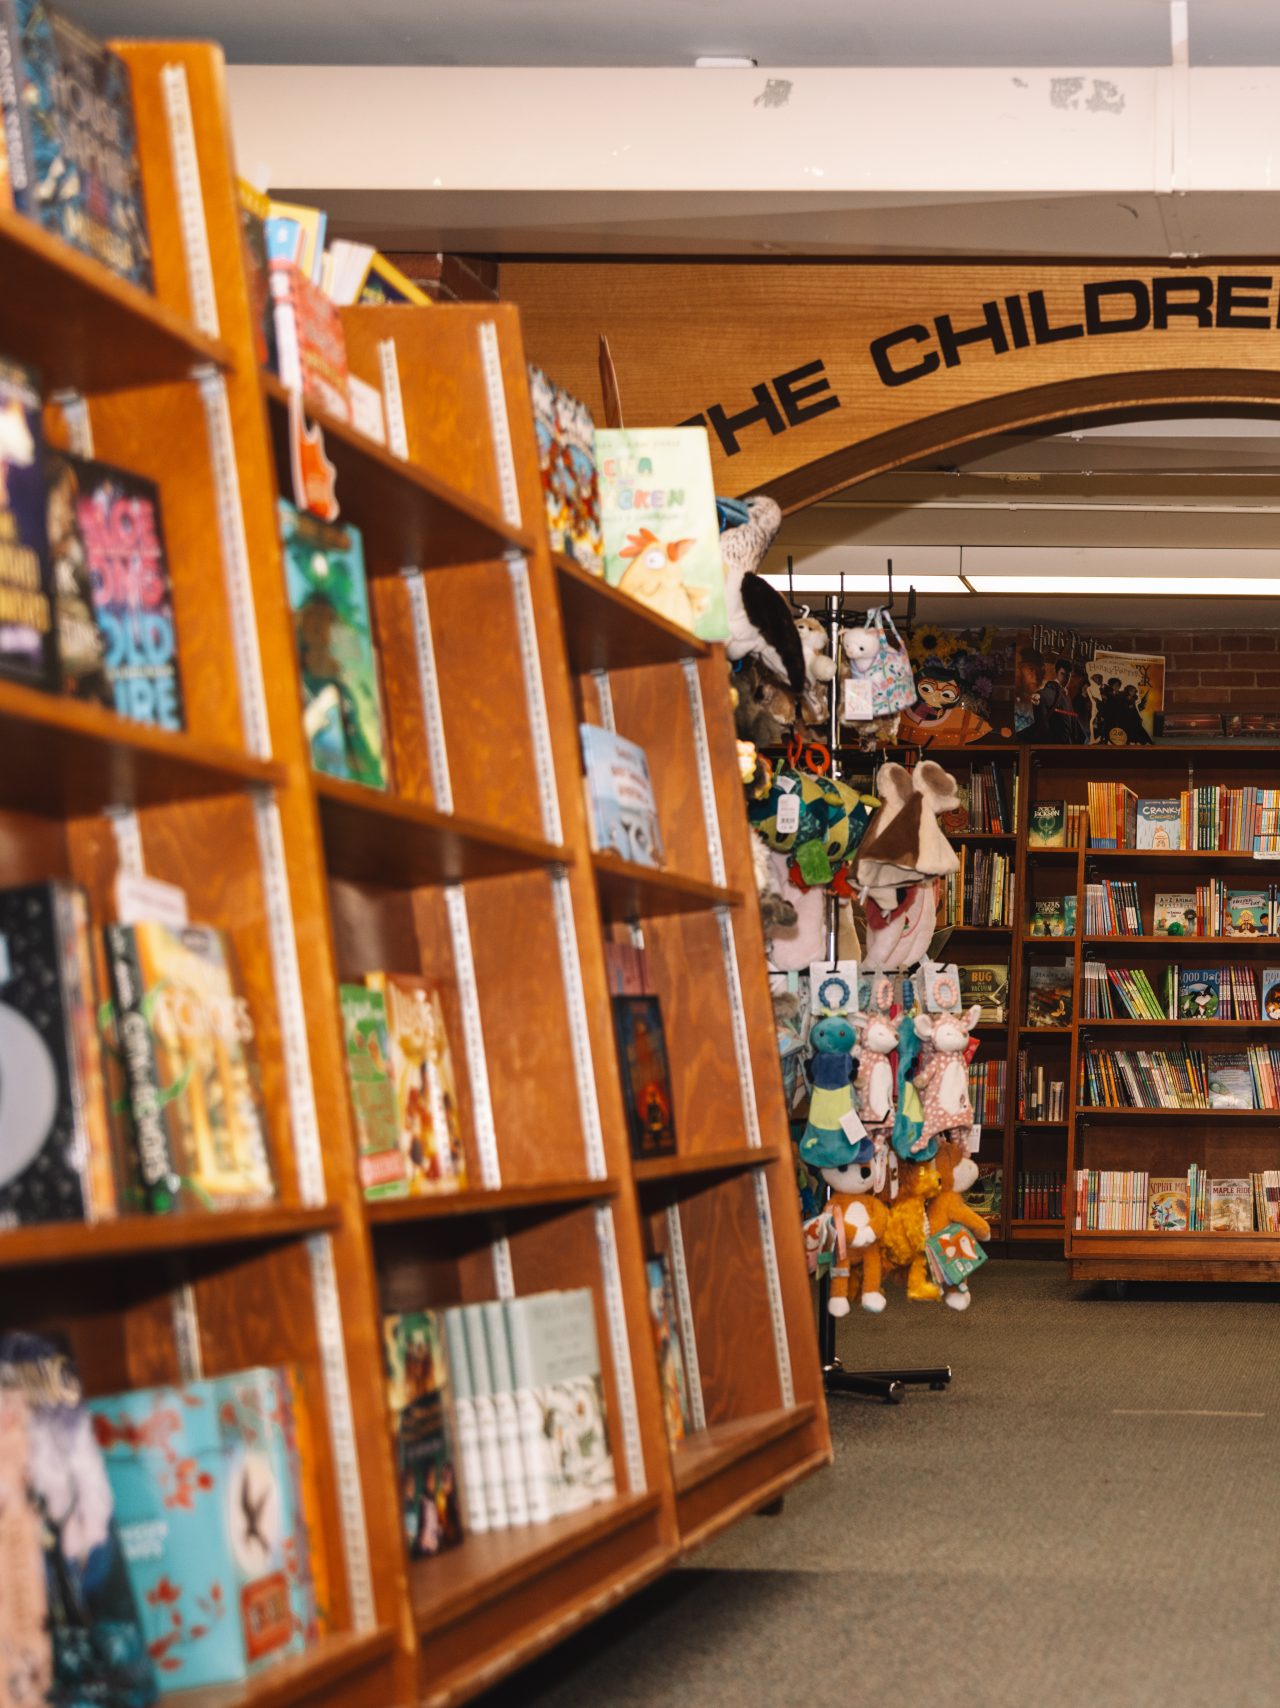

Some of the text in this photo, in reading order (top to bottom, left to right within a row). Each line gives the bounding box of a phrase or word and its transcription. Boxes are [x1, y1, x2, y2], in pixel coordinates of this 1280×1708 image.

[675, 359, 841, 457] HE
[1142, 806, 1181, 815] CRANKY
[971, 971, 993, 982] BUG
